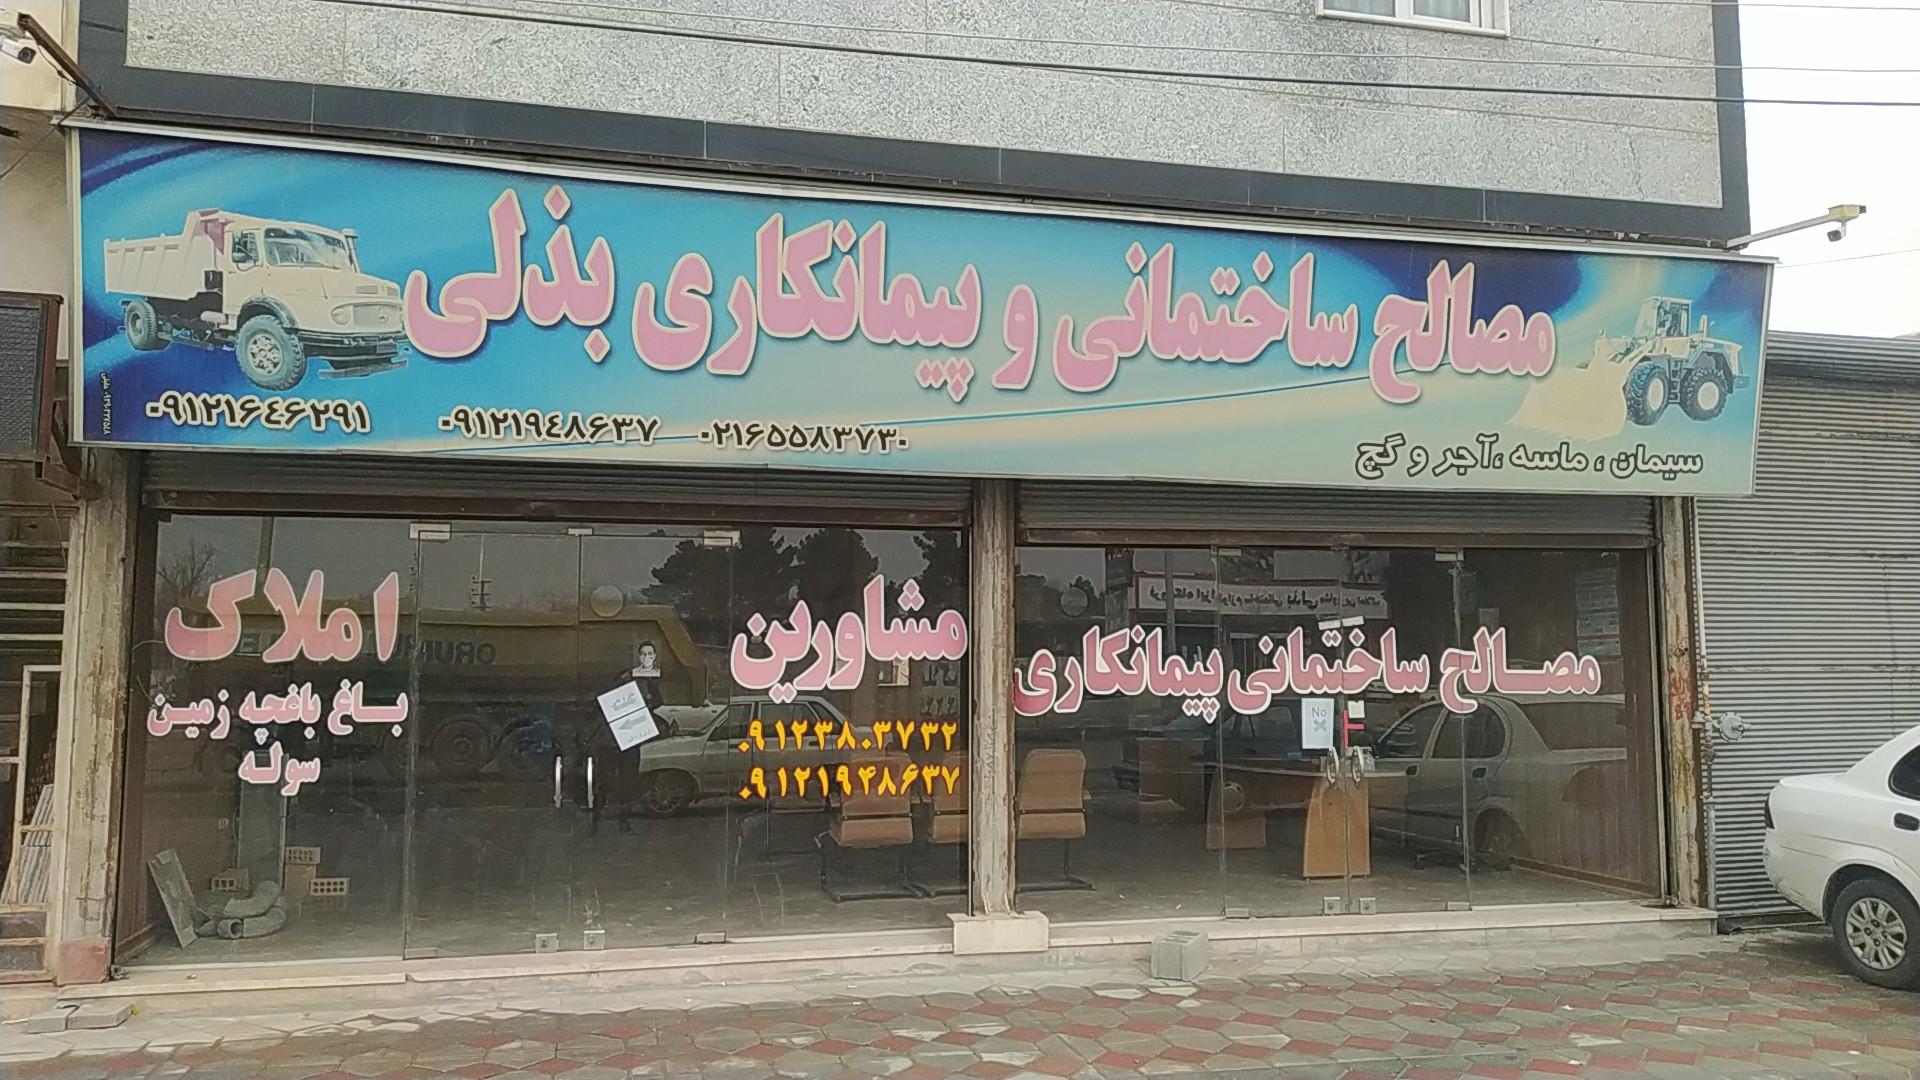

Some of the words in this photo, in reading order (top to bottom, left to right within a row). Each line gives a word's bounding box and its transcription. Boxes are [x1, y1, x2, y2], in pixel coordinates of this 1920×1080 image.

[403, 185, 615, 363] بذلی
[631, 213, 981, 402] پیمانکاری
[1052, 242, 1359, 393] ساختمانی
[992, 283, 1039, 390] و
[1368, 258, 1557, 404] مصالح
[1355, 432, 1406, 480] گچ
[1407, 445, 1430, 477] و
[1509, 441, 1588, 470] ماسه
[1609, 444, 1704, 480] سیمان
[164, 567, 399, 663] املاک
[731, 574, 968, 704] مشاورین
[239, 682, 322, 745] باغچه
[327, 678, 409, 737] باغ
[1013, 624, 1223, 724] پیمانکاری
[1227, 625, 1430, 714] ساختمانی
[1440, 626, 1602, 713] مصالح
[147, 688, 231, 740] زمین
[238, 741, 322, 796] سوله
